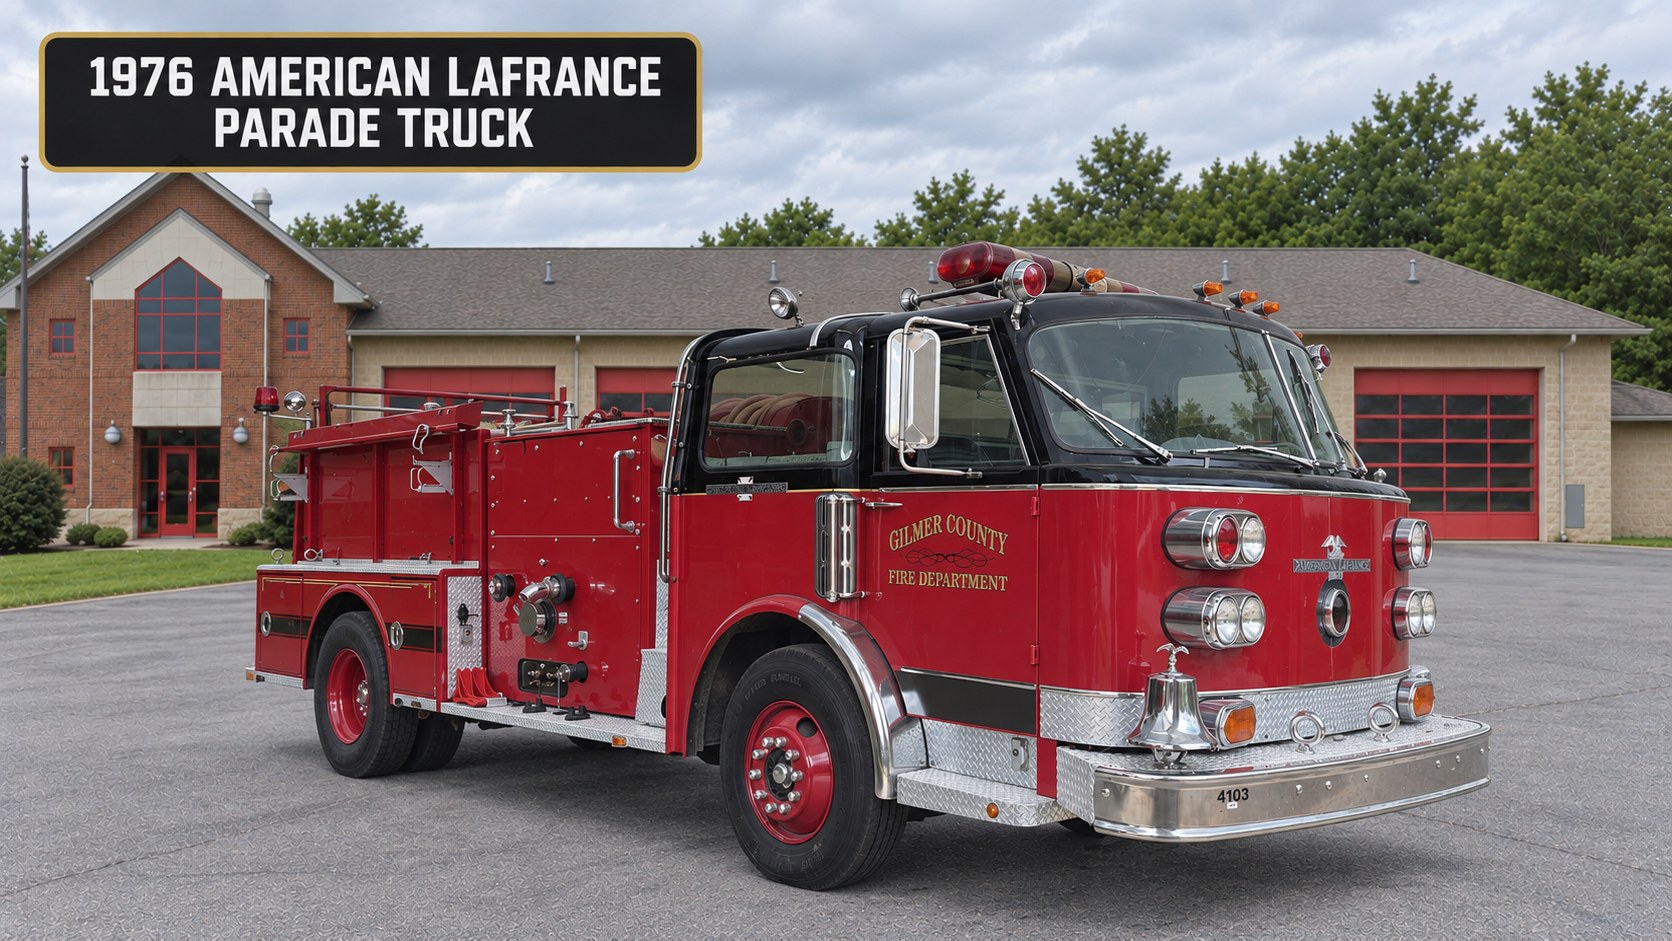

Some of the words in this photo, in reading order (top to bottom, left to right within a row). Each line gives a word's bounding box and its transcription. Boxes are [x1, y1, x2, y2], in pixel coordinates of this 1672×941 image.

[889, 514, 943, 551] GILMER
[946, 513, 1009, 555] COUNTY
[888, 569, 916, 585] FIRE
[919, 571, 1009, 591] DEPARTMENT
[1217, 788, 1249, 803] 4103
